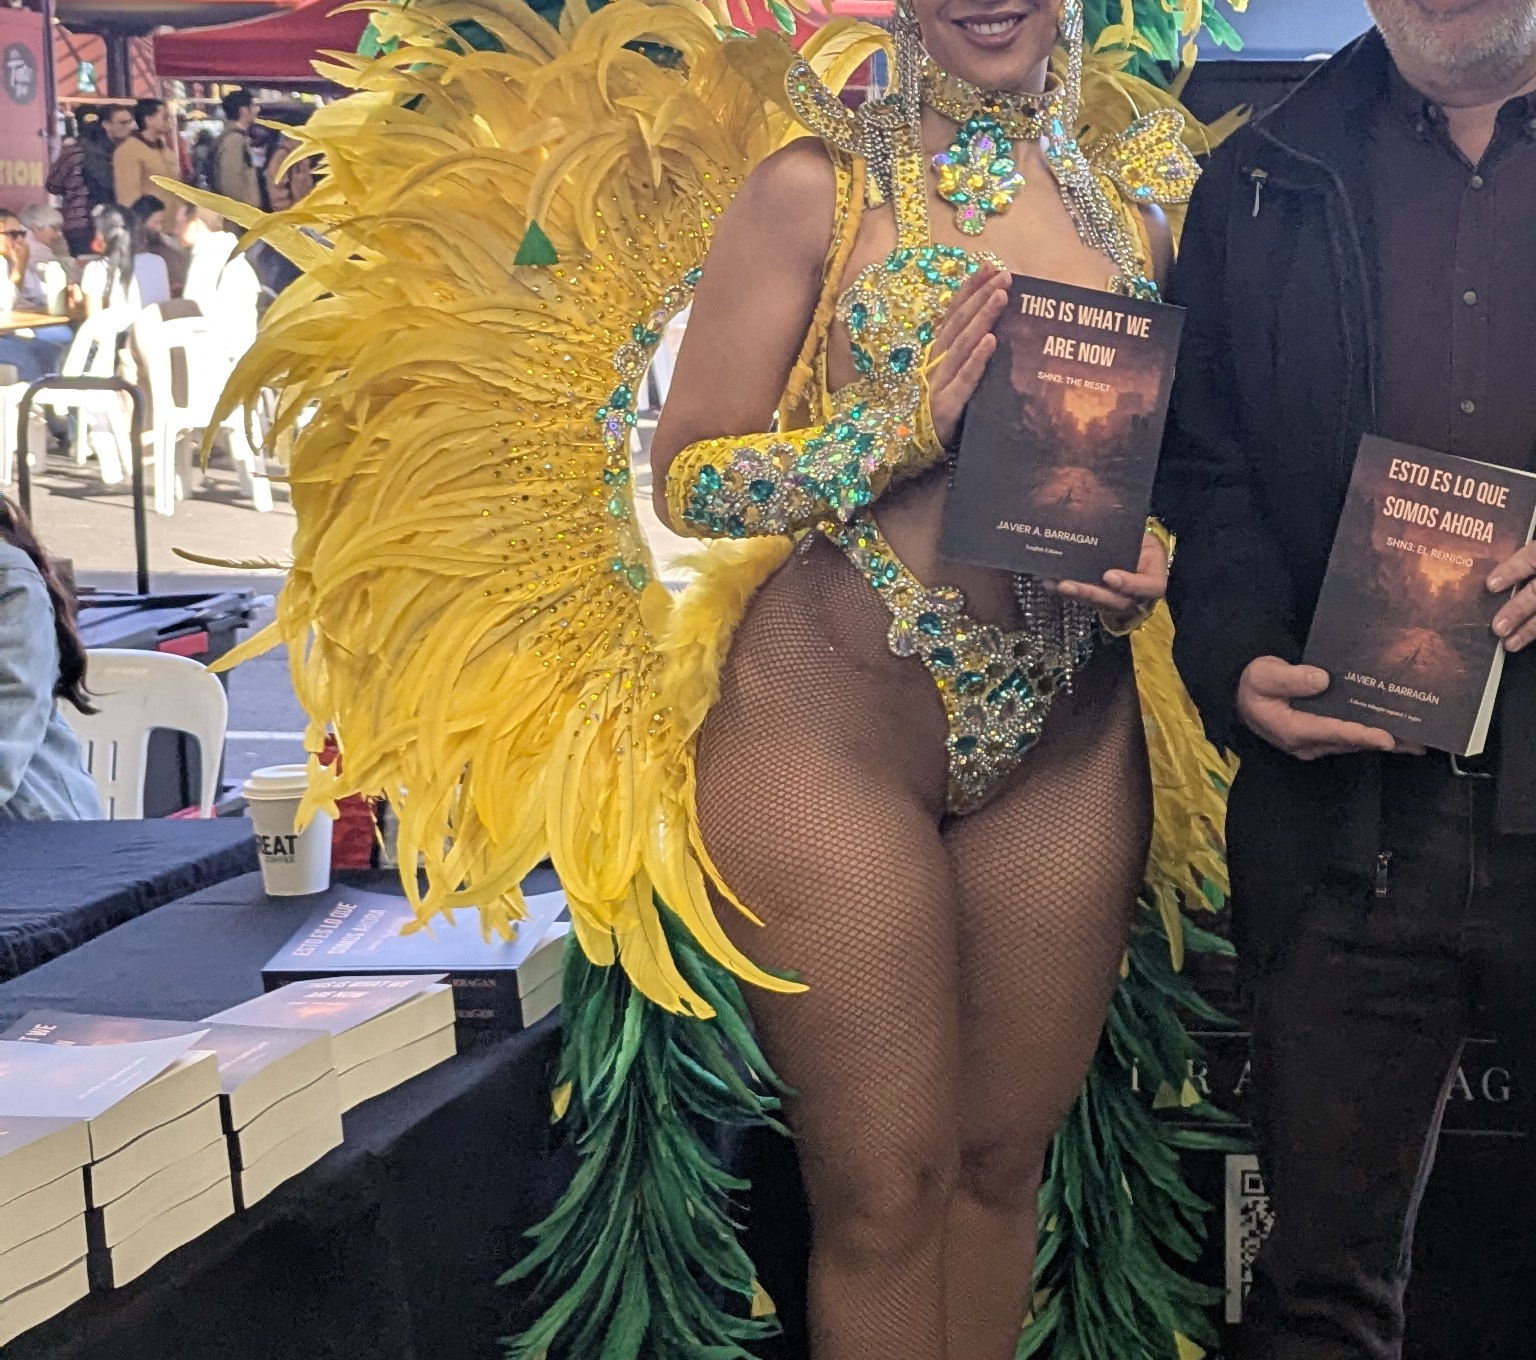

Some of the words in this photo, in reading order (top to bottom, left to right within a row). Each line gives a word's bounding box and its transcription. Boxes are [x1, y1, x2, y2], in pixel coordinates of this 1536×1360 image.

[1021, 293, 1057, 320] THIS
[1058, 300, 1075, 323] IS
[1077, 304, 1125, 333] WHAT
[1126, 314, 1152, 339] WE
[1043, 335, 1076, 360] ARE
[1078, 341, 1117, 367] NOW
[1066, 376, 1083, 387] THE
[1084, 380, 1111, 392] RESET
[1389, 458, 1430, 489] ESTO
[1430, 469, 1453, 494] ES
[1454, 476, 1475, 500] LO
[1476, 480, 1510, 509] QUE
[997, 520, 1032, 535] JAVIER
[1044, 528, 1099, 546] BARRAGAN
[1383, 495, 1438, 530] SOMOS
[1439, 511, 1494, 545] AHORA
[1386, 536, 1416, 553] SHN3:
[1416, 545, 1428, 556] EL
[1430, 549, 1474, 567] REINICIO
[1344, 671, 1377, 687] JAVIER
[1388, 683, 1440, 705] BARRAGÁN
[292, 938, 323, 956] ESTO
[329, 901, 358, 919] QUE
